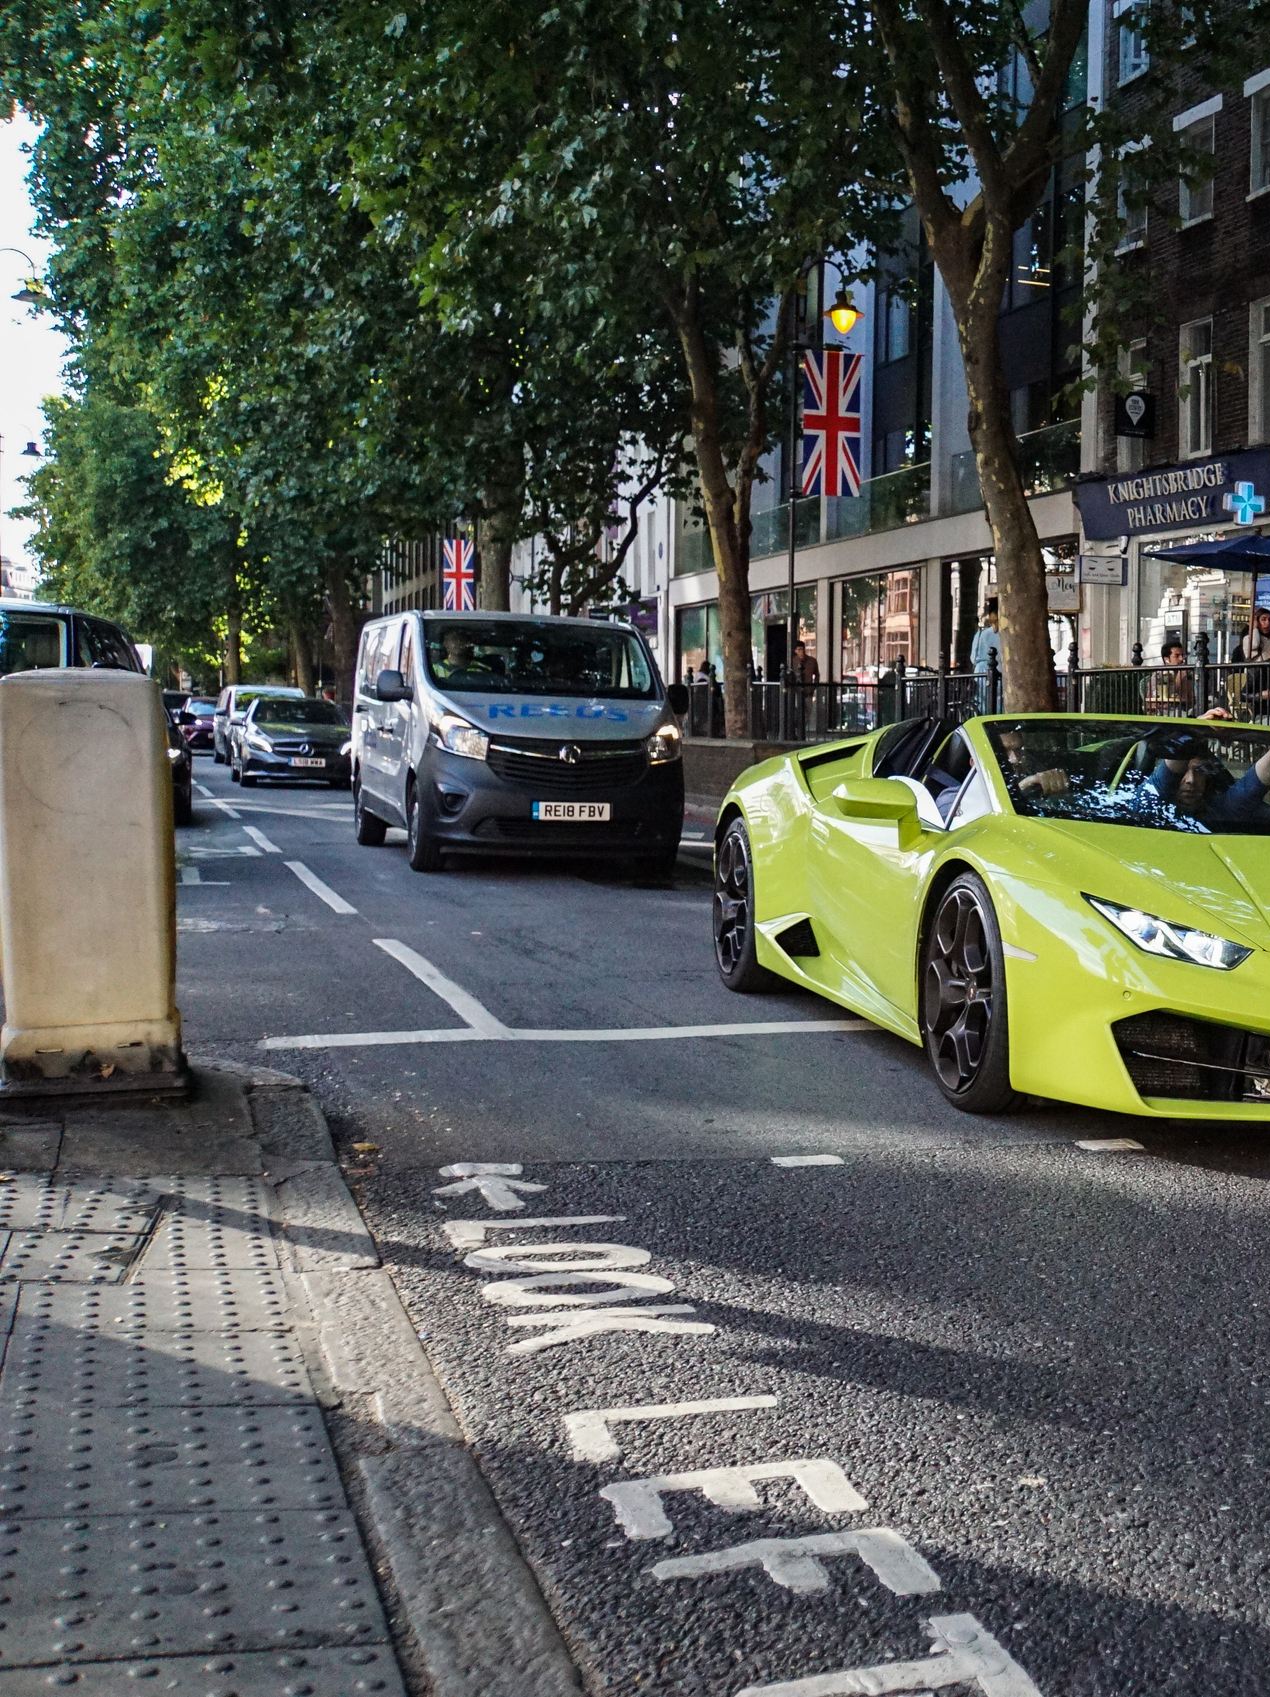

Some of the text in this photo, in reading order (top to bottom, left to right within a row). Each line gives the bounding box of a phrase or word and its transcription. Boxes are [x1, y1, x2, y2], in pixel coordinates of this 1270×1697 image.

[1107, 462, 1224, 505] KNIGHTSBRIDGE
[1126, 495, 1209, 529] PHARMACY
[544, 804, 605, 818] RE18 FBV
[443, 1214, 717, 1355] LOOK
